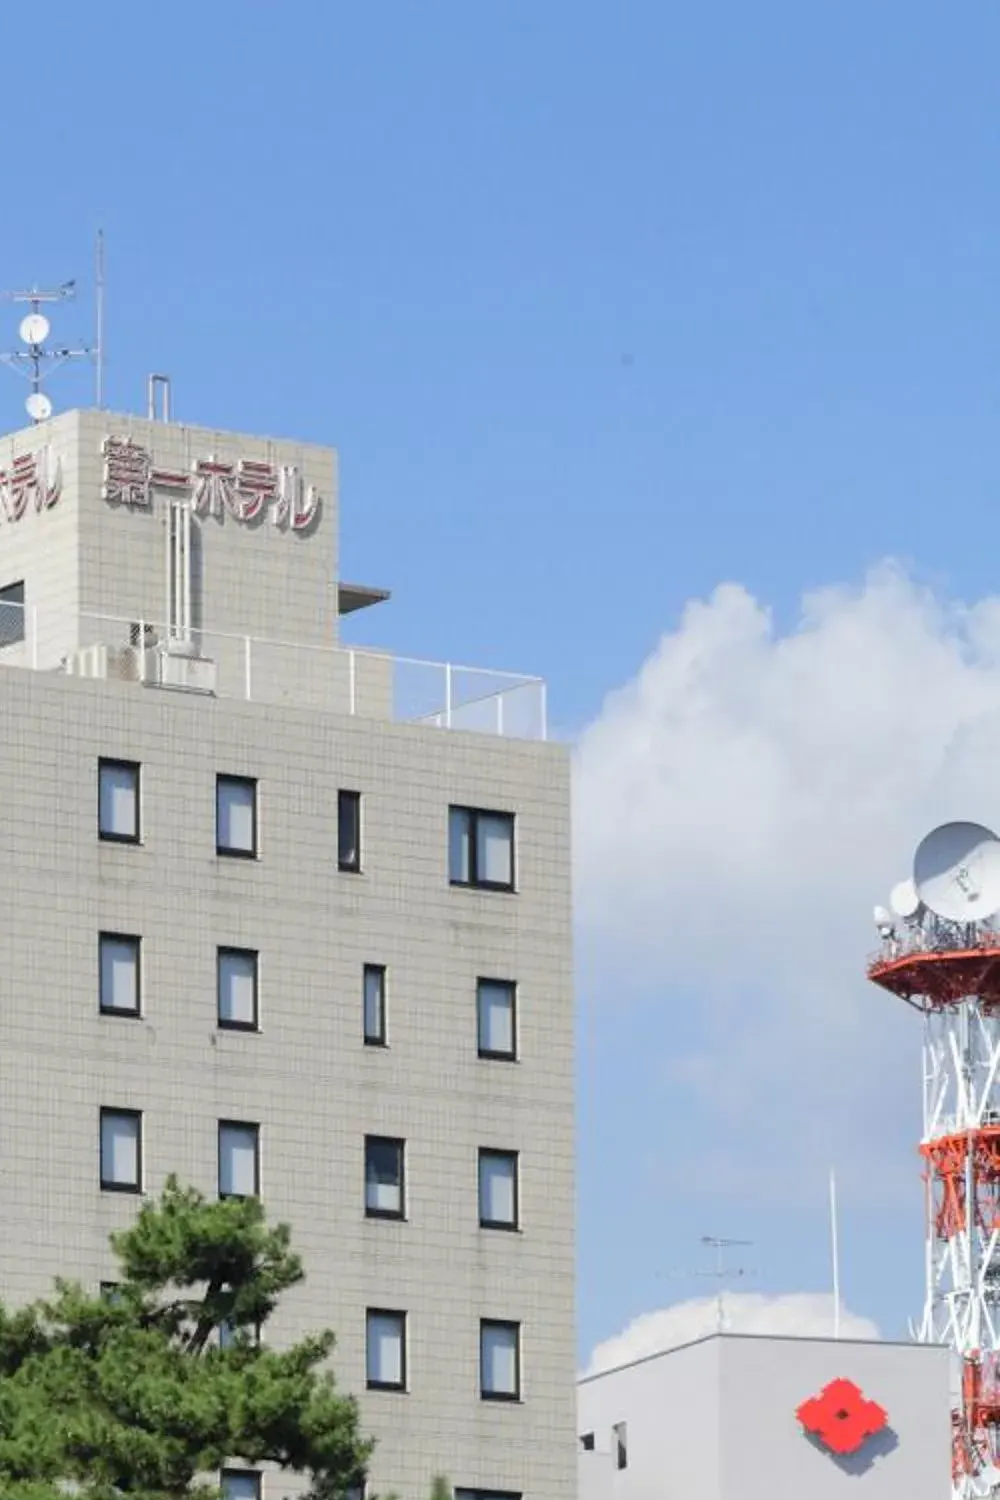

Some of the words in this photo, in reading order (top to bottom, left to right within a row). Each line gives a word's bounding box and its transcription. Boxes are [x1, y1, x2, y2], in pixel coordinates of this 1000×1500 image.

[101, 434, 319, 529] 第一ホテル
